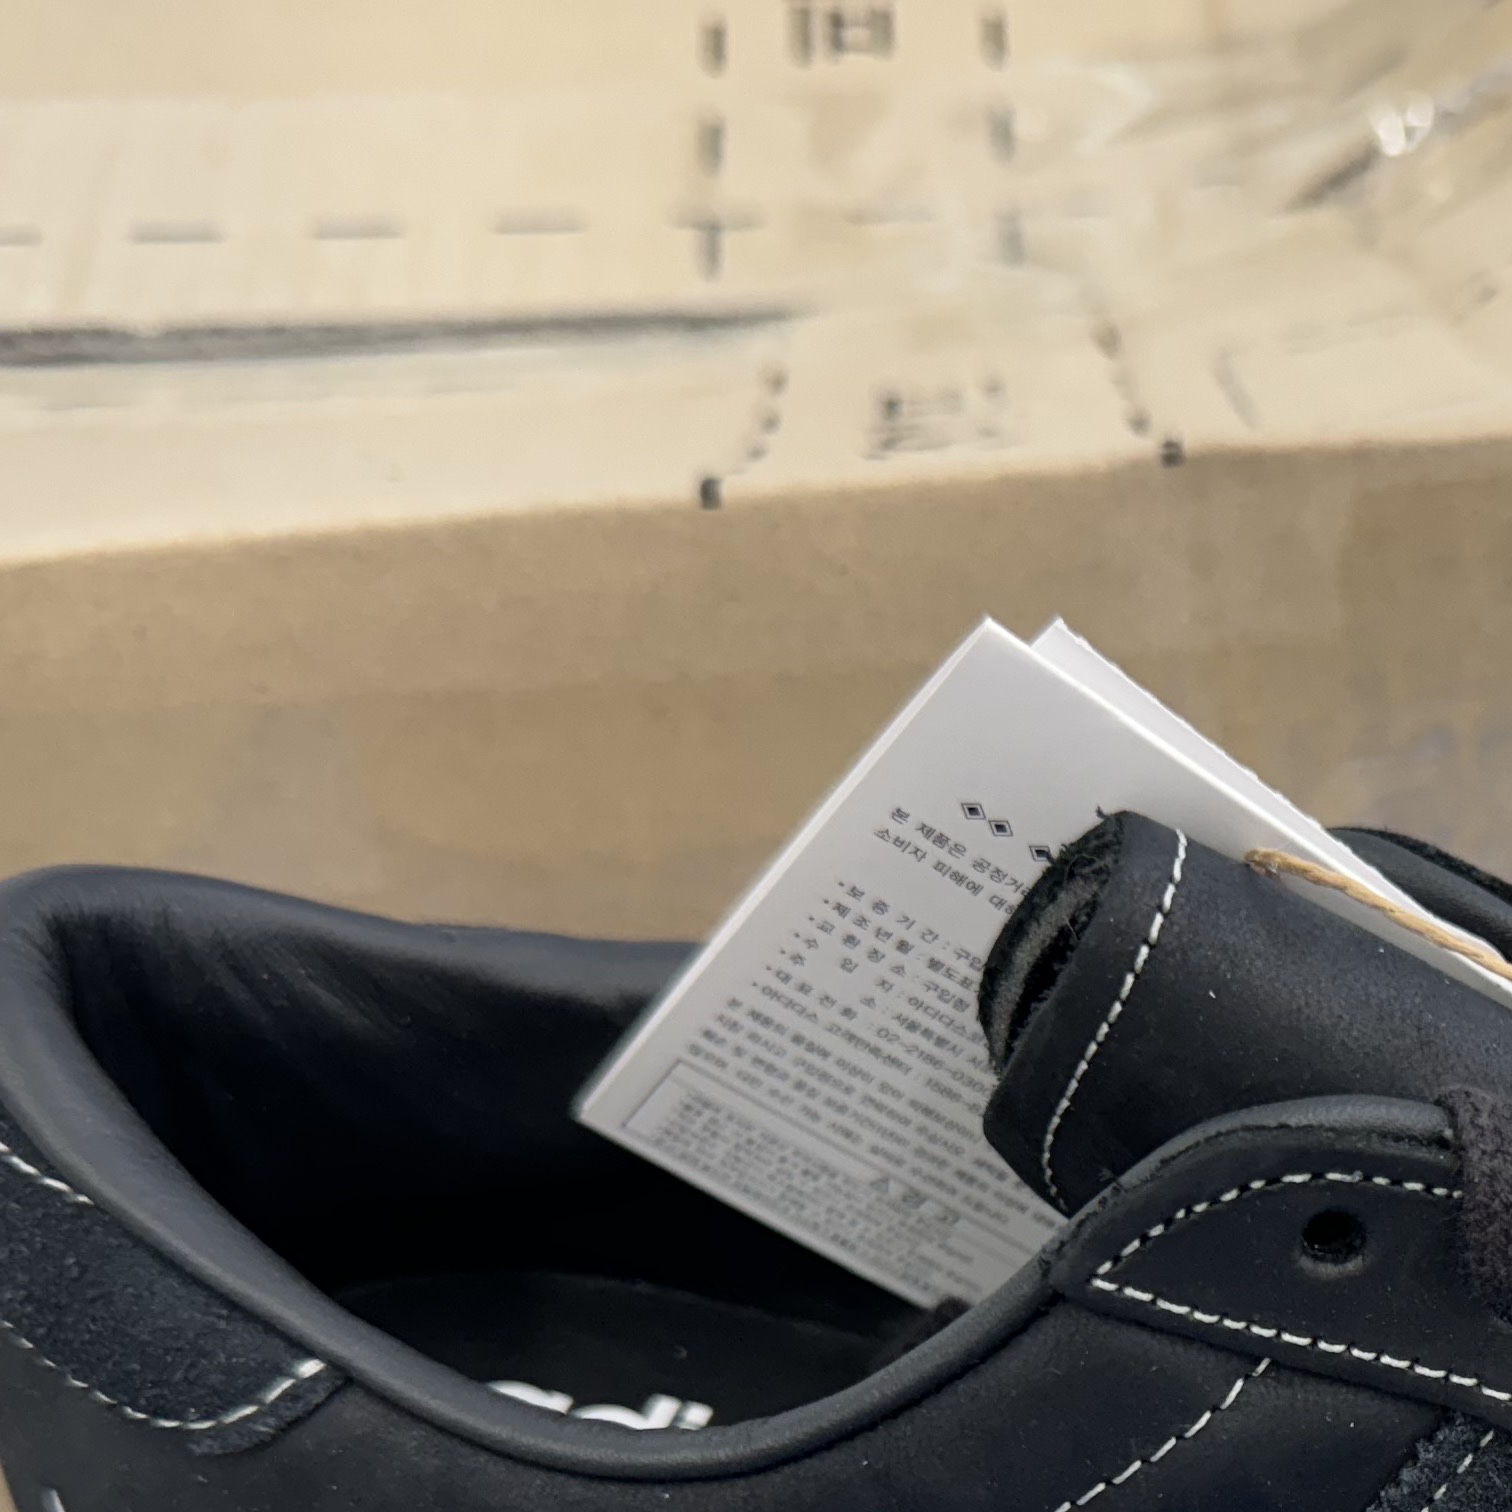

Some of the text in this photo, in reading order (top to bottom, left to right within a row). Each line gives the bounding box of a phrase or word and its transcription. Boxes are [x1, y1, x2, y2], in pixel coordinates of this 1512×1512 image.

[873, 828, 927, 862] 소비자
[932, 858, 984, 896] 피해에
[889, 806, 910, 824] 본
[914, 821, 966, 859] 제품은
